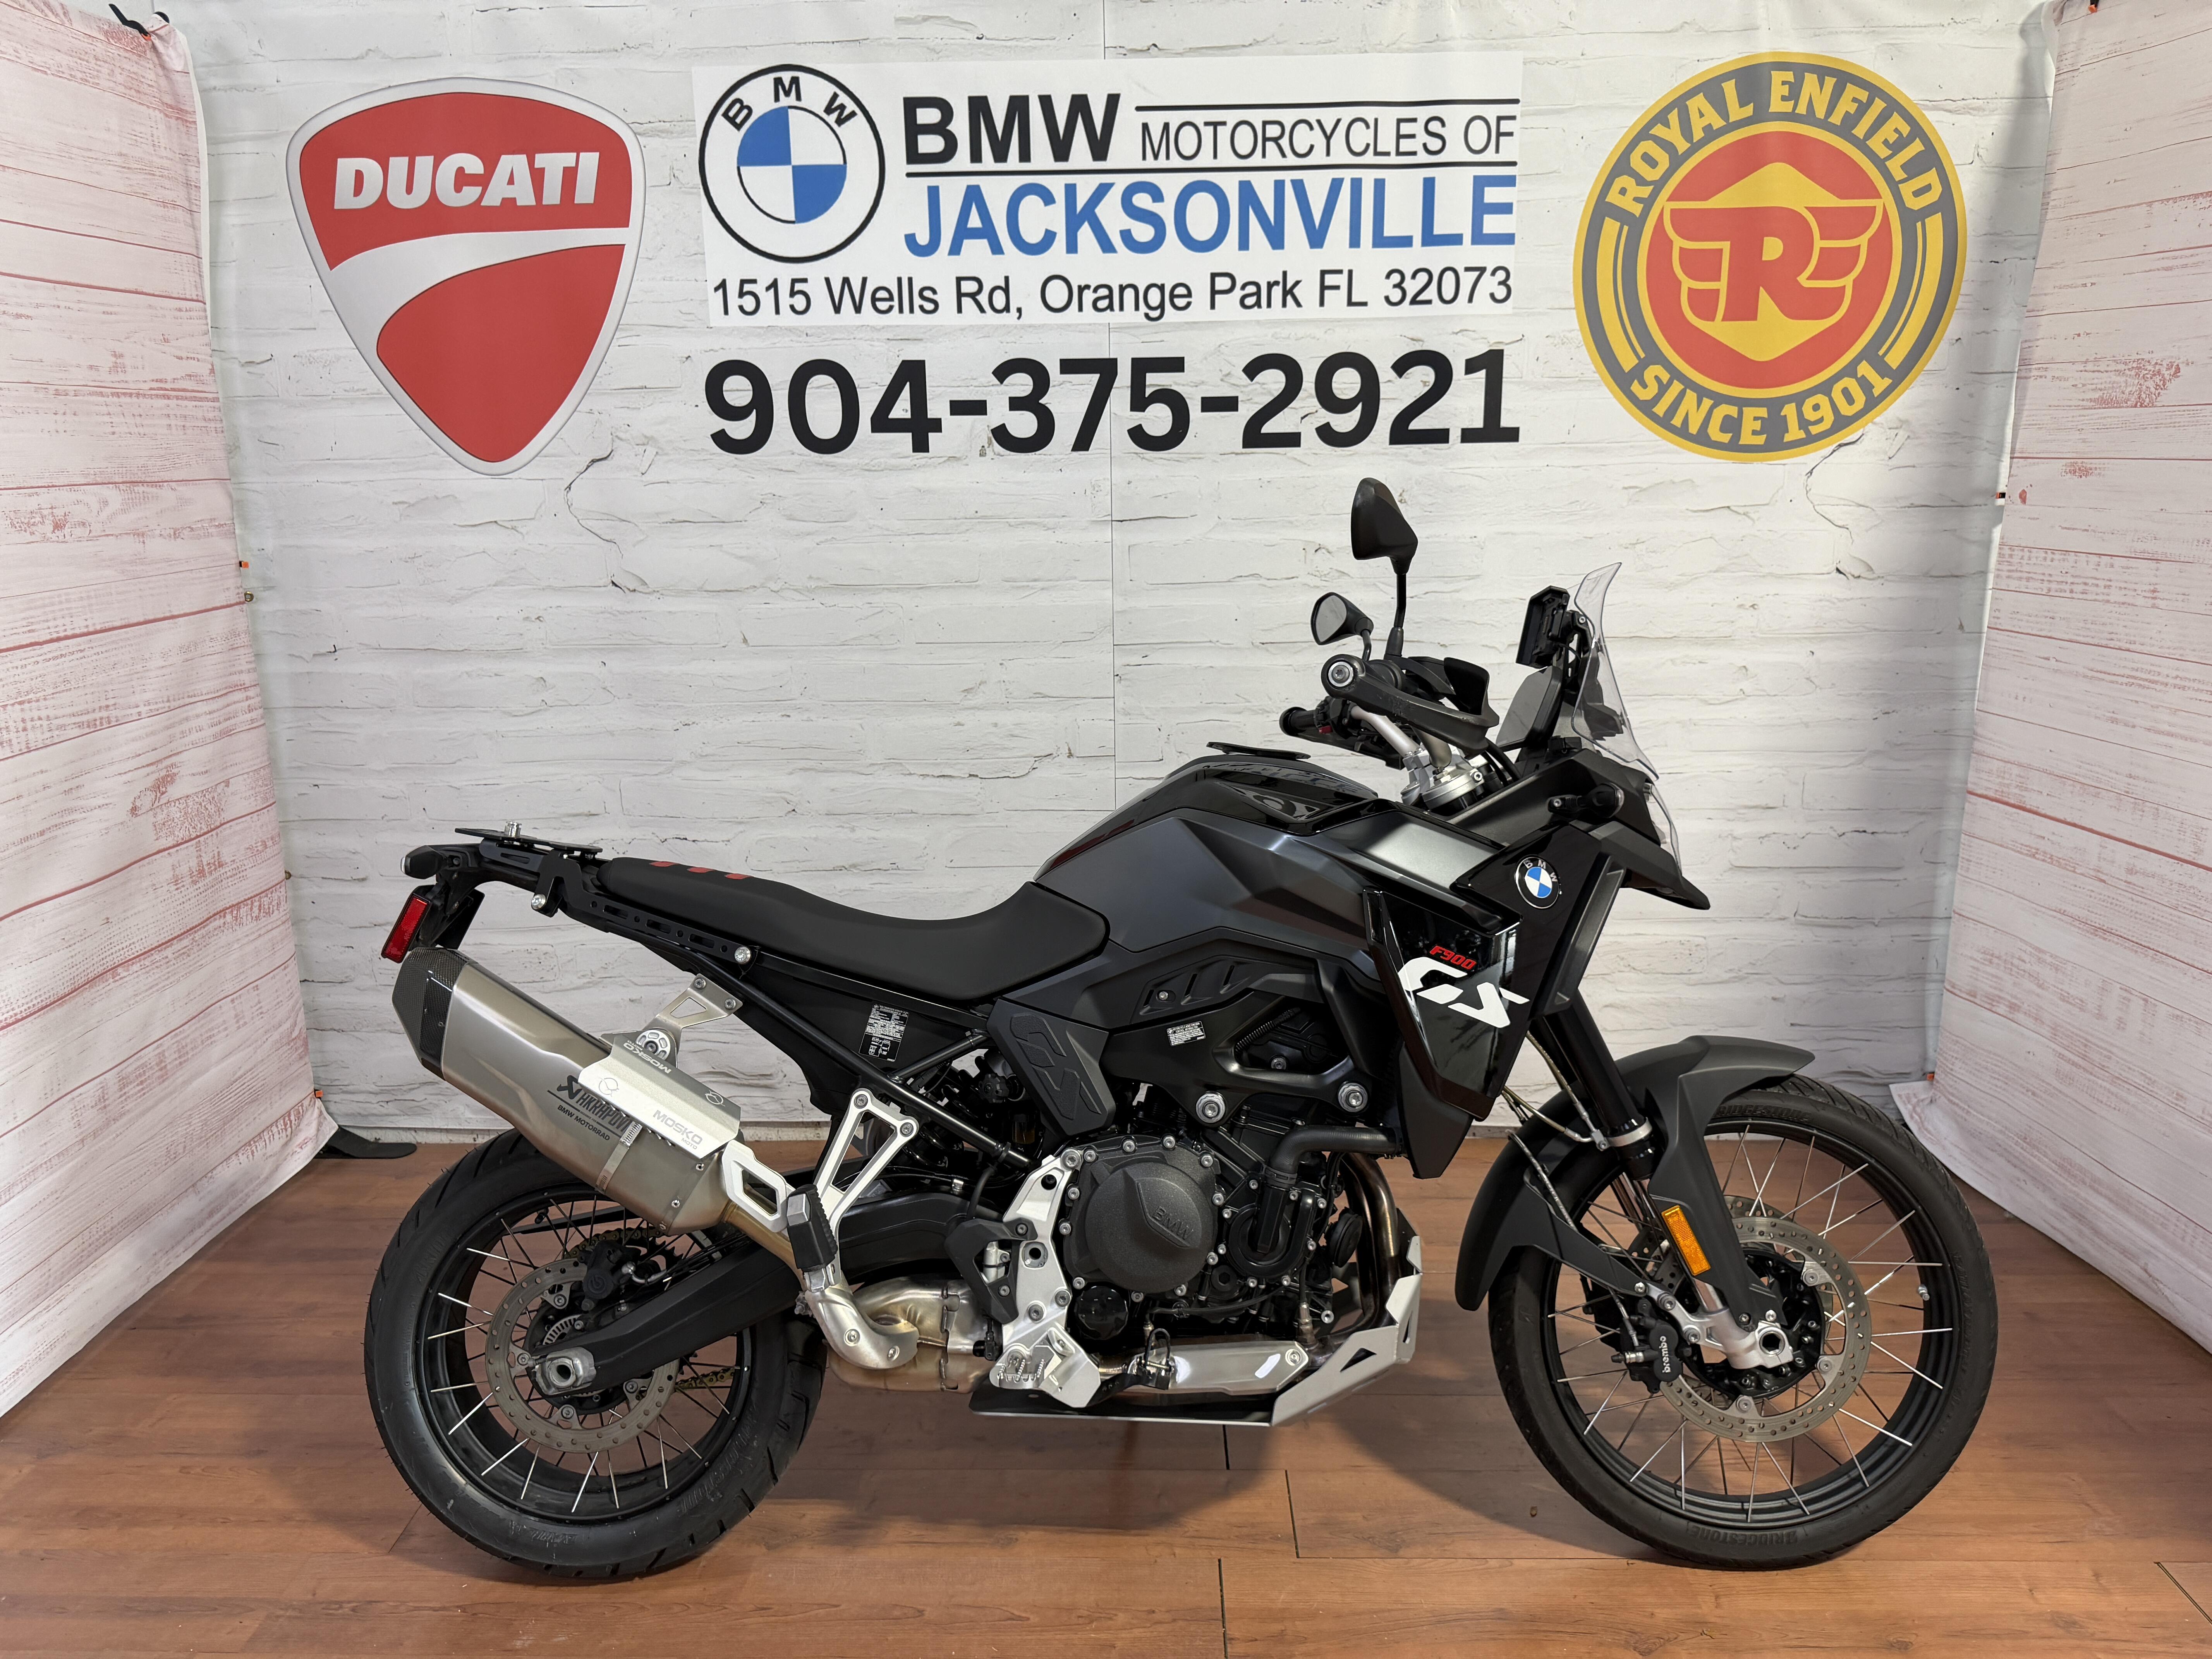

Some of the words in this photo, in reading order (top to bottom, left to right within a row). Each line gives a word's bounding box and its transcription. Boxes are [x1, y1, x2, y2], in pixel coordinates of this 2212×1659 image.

[721, 76, 858, 132] BMW
[903, 93, 1121, 165] BMW
[1141, 115, 1447, 162] MOTORCYCLES
[1463, 115, 1517, 155] OF
[1604, 79, 1753, 218] ROYAL
[1769, 70, 1942, 211] ENFIELD
[334, 152, 599, 210] DUCATI
[904, 174, 1517, 259] JACKSONVILLE
[713, 277, 811, 317] 1515
[824, 276, 939, 316] Wells
[956, 275, 1023, 320] Rd,
[1040, 274, 1192, 322] Orange
[1209, 270, 1302, 311] Park
[1319, 269, 1367, 308] FL
[1384, 266, 1513, 307] 32073
[704, 349, 1520, 455] 904-375-2921
[1630, 364, 1768, 445] SINCE
[1781, 359, 1892, 443] 1901
[1523, 859, 1558, 882] BMW
[1429, 945, 1477, 970] F900
[623, 1042, 672, 1073] MOSKO
[557, 1105, 575, 1118] BMW
[574, 1115, 610, 1140] MOTORRAD
[576, 1092, 633, 1132] AKRAPOVI
[653, 1110, 703, 1145] MOSKO
[1716, 1104, 1812, 1121] RIDGESTONE
[682, 1138, 697, 1149] MOTO
[1152, 1206, 1194, 1240] BMW
[1659, 1336, 1671, 1373] brembo
